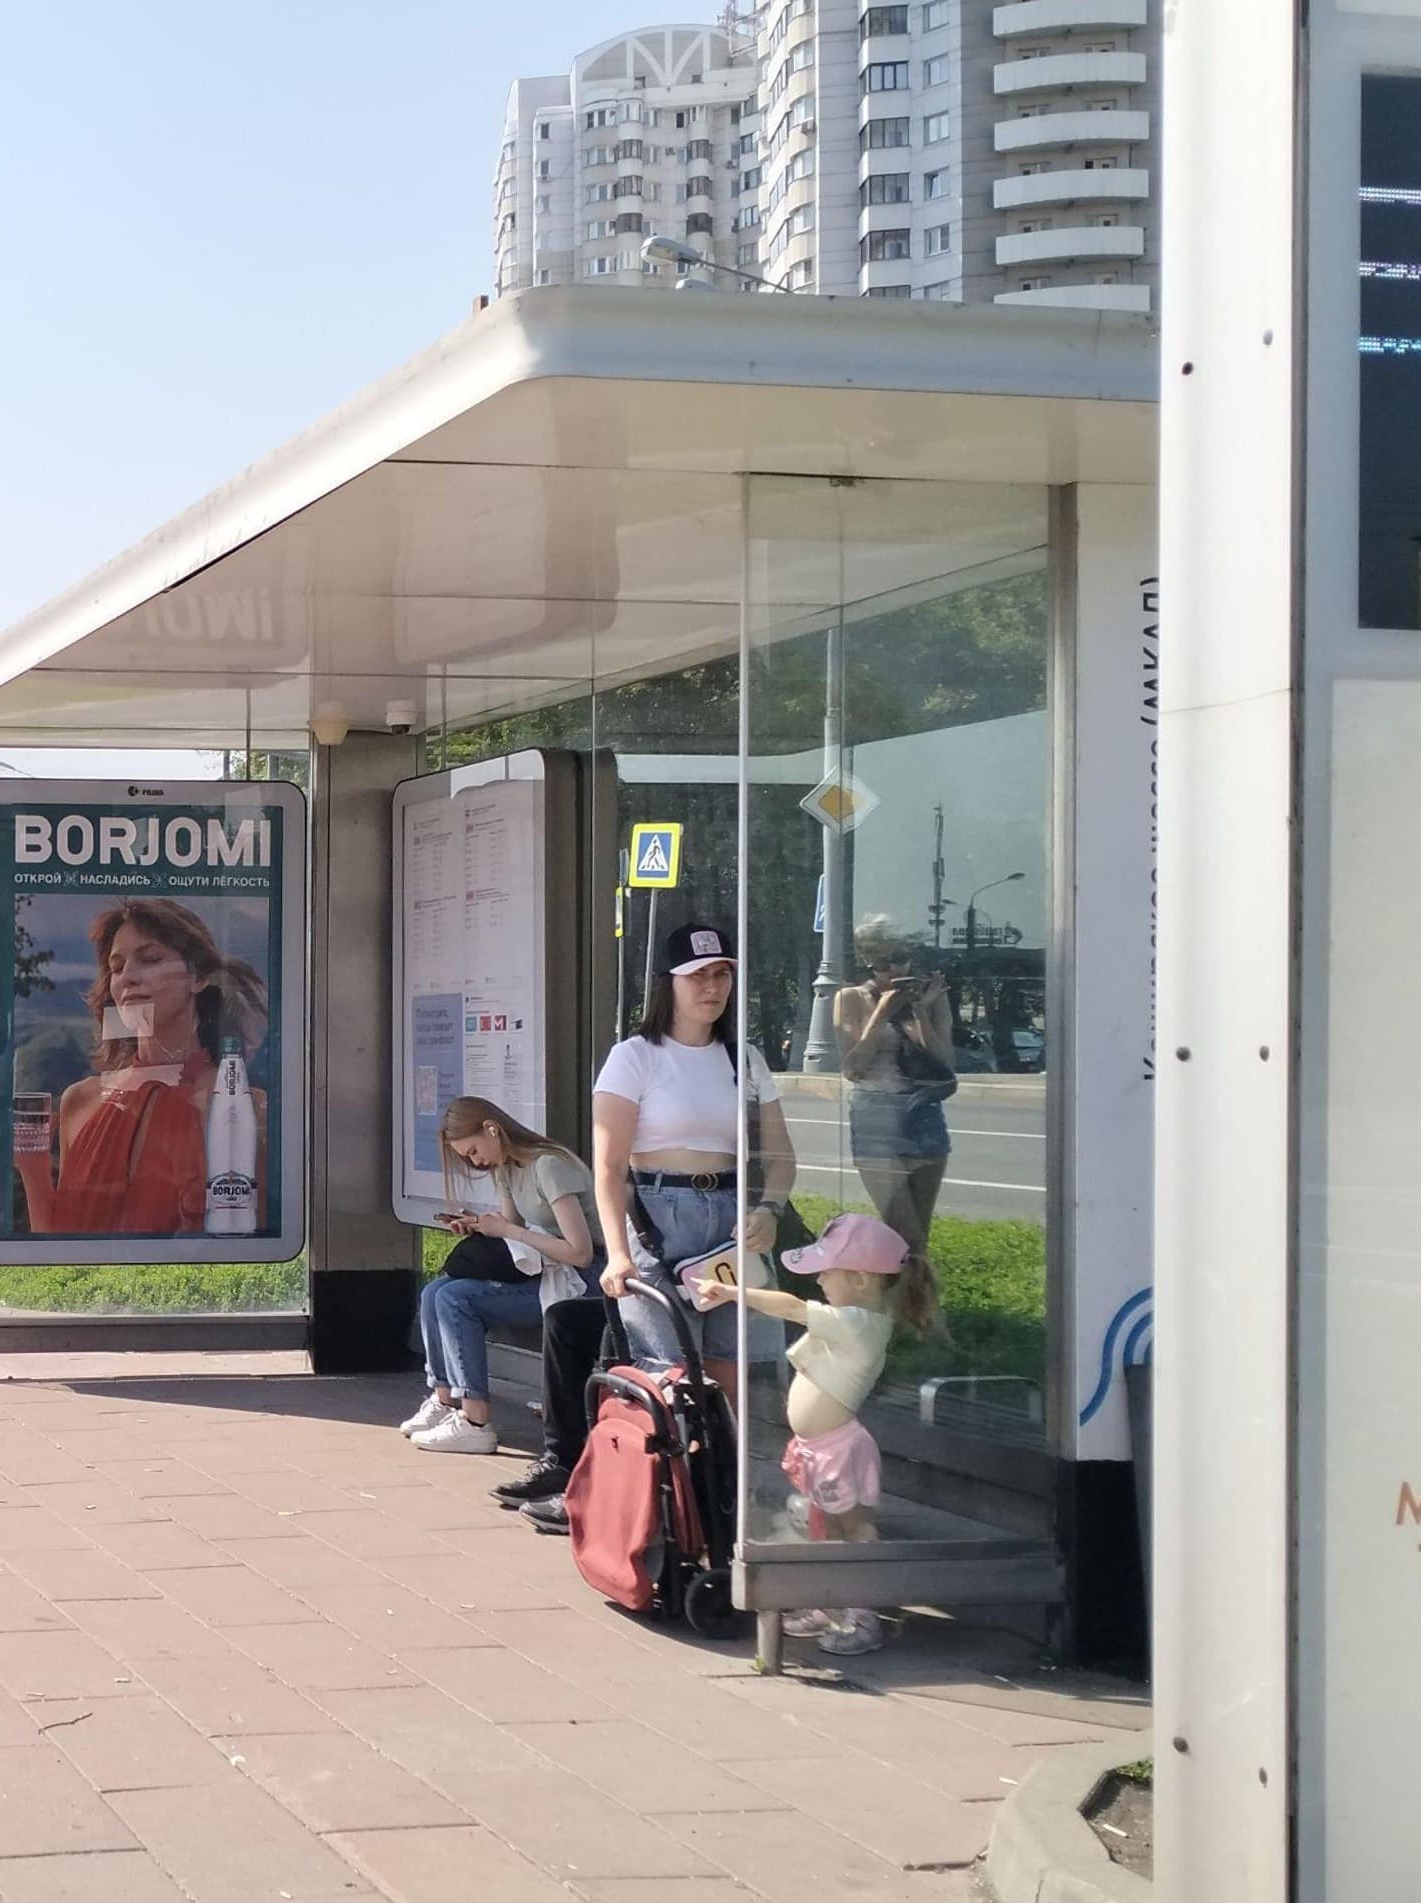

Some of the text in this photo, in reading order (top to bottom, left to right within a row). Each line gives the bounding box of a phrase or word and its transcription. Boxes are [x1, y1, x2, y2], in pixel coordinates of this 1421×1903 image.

[14, 814, 271, 868] BORJOMI
[14, 872, 62, 884] ОТКРОЙ
[80, 874, 151, 886] НАСЛАДИСЬ
[168, 876, 209, 888] ОЩУТИ
